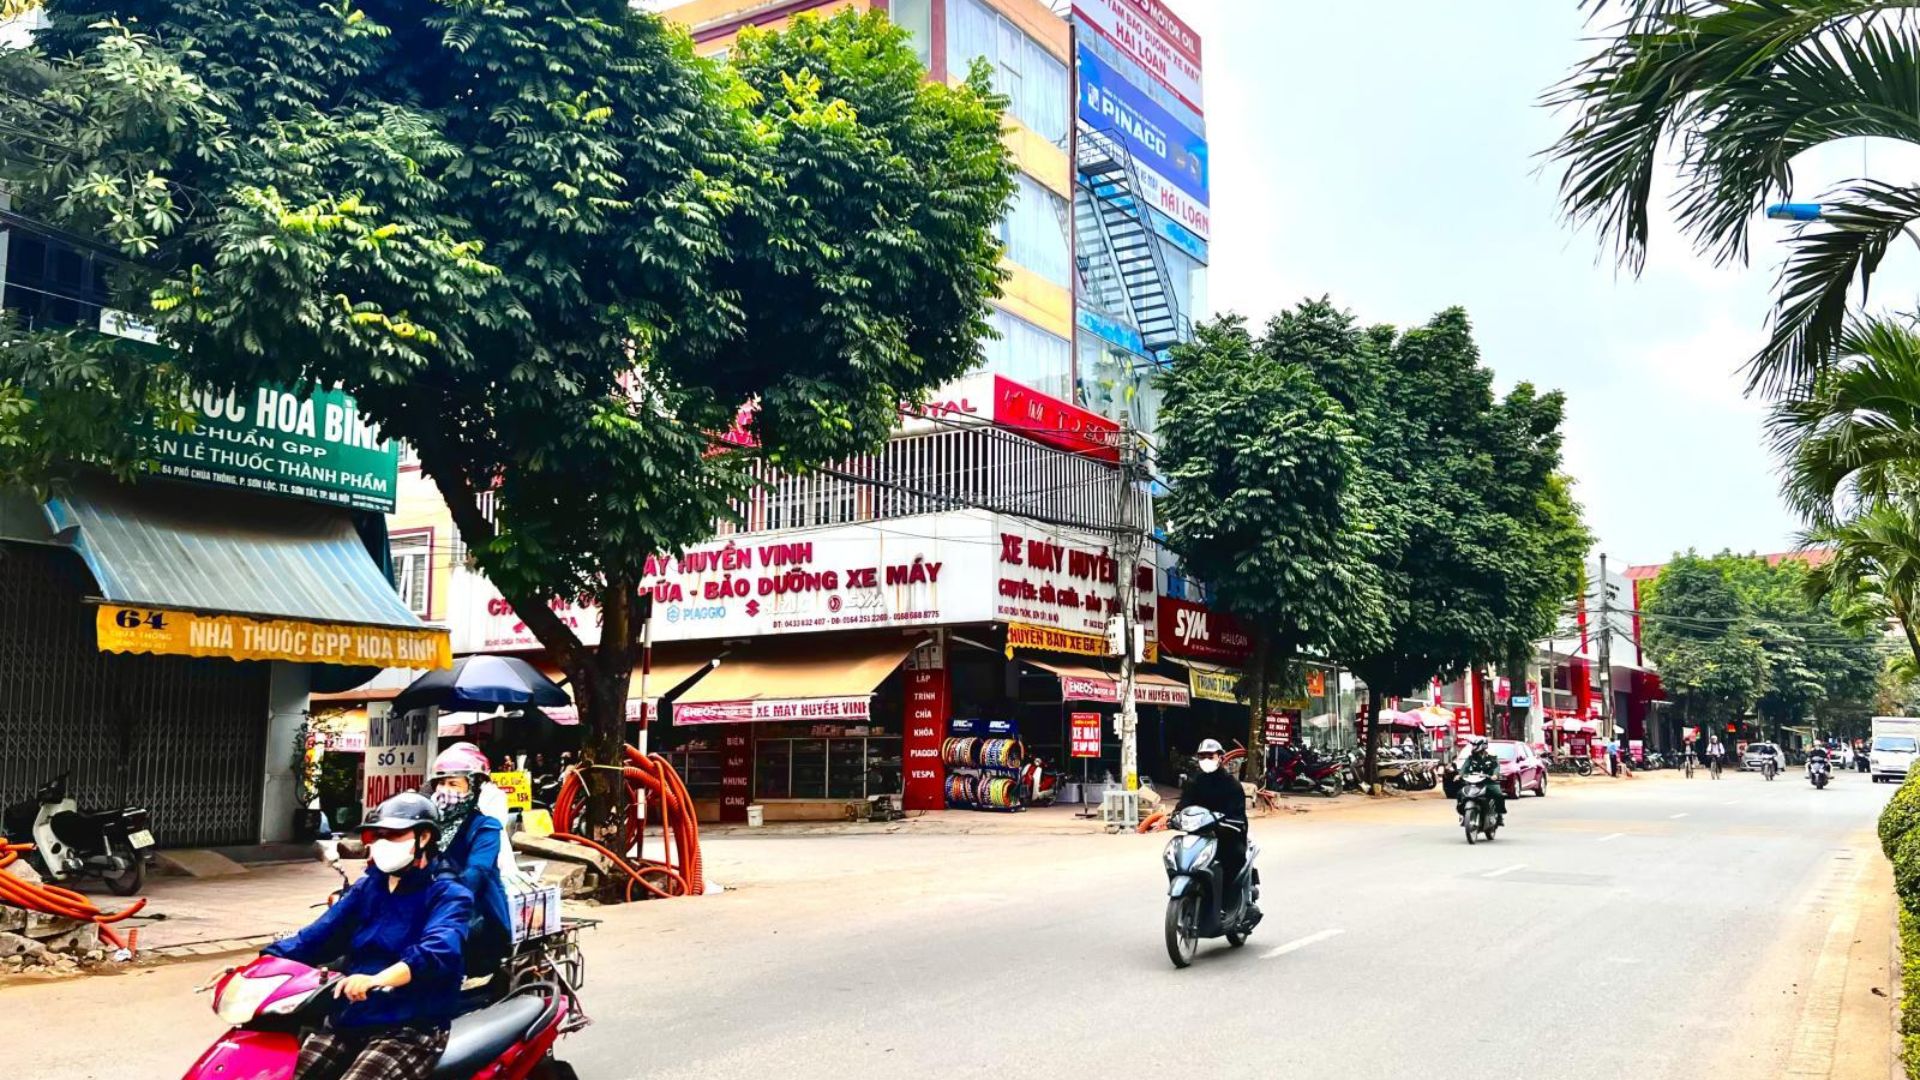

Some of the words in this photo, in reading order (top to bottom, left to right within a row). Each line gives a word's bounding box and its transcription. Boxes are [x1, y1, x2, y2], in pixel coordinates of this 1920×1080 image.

[1150, 3, 1181, 39] MOTOR
[1181, 32, 1196, 54] OIL
[1138, 40, 1166, 77] LOAN
[1102, 95, 1166, 159] PINACO
[1182, 201, 1209, 234] LOAN
[282, 441, 327, 458] GPP
[183, 441, 206, 460] LẺ
[209, 448, 274, 472] THUỐC
[278, 461, 336, 483] THÀNH
[340, 472, 387, 493] PHẨM
[758, 542, 813, 567] VINH
[1000, 533, 1023, 565] XE
[1028, 537, 1065, 574] MÁY
[704, 574, 750, 600] BẢO
[757, 567, 838, 596] DƯỠNG
[846, 568, 877, 589] XE
[886, 557, 942, 587] MÁY
[116, 609, 168, 630] 64
[683, 606, 726, 622] PIAGGIO
[1174, 609, 1209, 646] SYM
[242, 622, 307, 656] THUỐC
[311, 632, 351, 656] GPP
[357, 635, 394, 658] HOA
[397, 634, 437, 661] BÌNH
[1070, 636, 1082, 650] XE
[1083, 638, 1095, 651] GA
[1069, 682, 1093, 694] ENEOS
[756, 708, 769, 717] XE
[378, 747, 395, 765] SỐ
[401, 752, 415, 765] 14
[910, 749, 938, 757] PIAGGIO
[912, 770, 935, 778] VESPA
[366, 775, 390, 808] HOA
